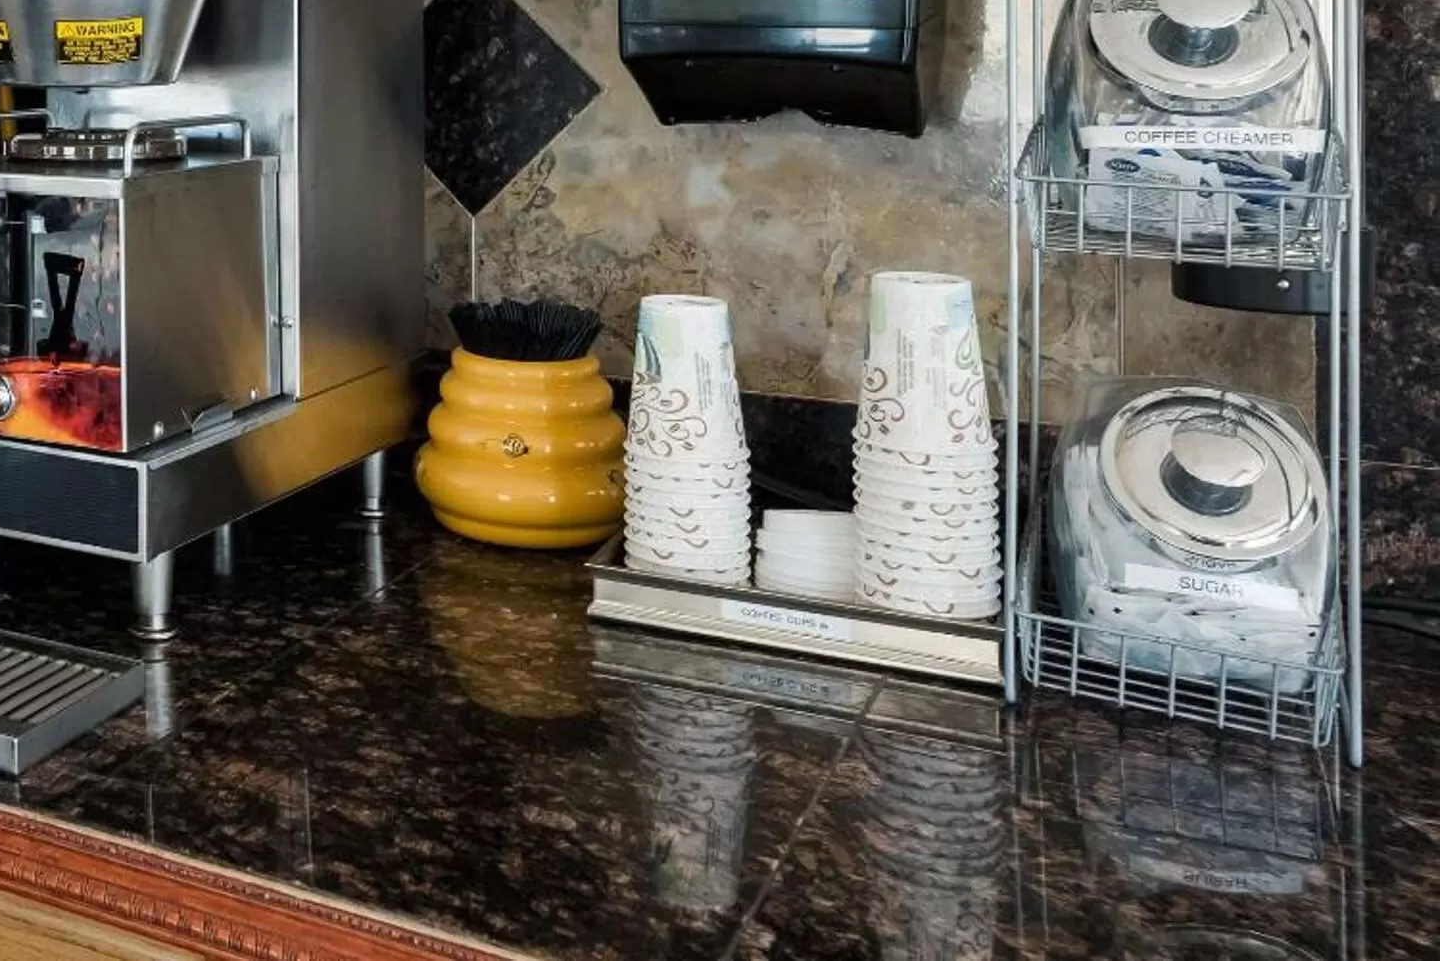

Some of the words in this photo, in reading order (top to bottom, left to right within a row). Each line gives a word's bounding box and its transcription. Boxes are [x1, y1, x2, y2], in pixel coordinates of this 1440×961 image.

[76, 22, 136, 37] WARNING
[1125, 130, 1197, 144] COFFEE
[1203, 130, 1294, 145] CREAMER
[1179, 576, 1244, 597] SUGAR
